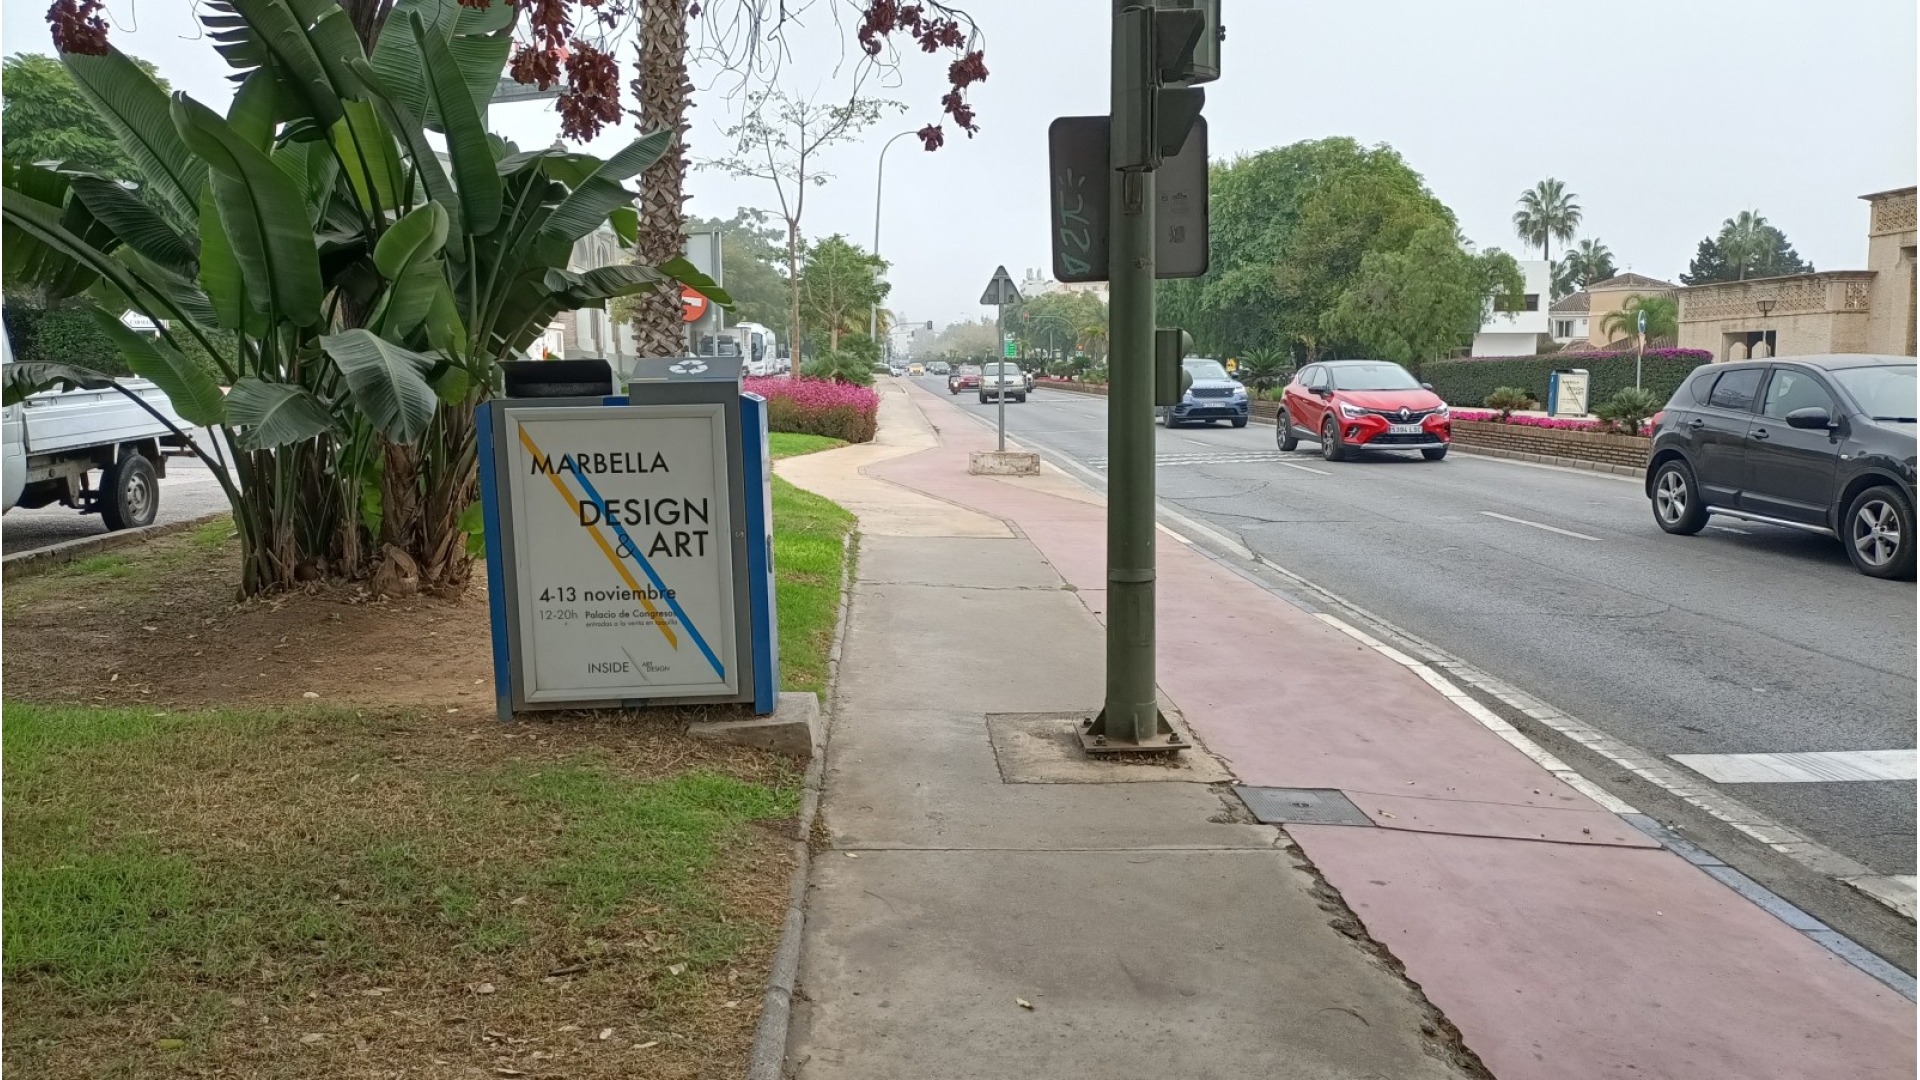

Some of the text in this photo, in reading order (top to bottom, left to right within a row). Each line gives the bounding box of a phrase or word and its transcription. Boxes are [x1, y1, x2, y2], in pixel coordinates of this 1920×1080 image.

[531, 451, 669, 475] MARBELLA
[579, 497, 709, 527] DESIGN
[615, 530, 709, 559] & ART
[539, 583, 676, 602] 4-13 noviembre
[539, 609, 579, 620] 12-20h
[585, 610, 617, 620] Palacio
[619, 609, 630, 618] de
[585, 620, 613, 628] entradas
[587, 661, 630, 674] INSIDE
[646, 665, 671, 673] DESIGN
